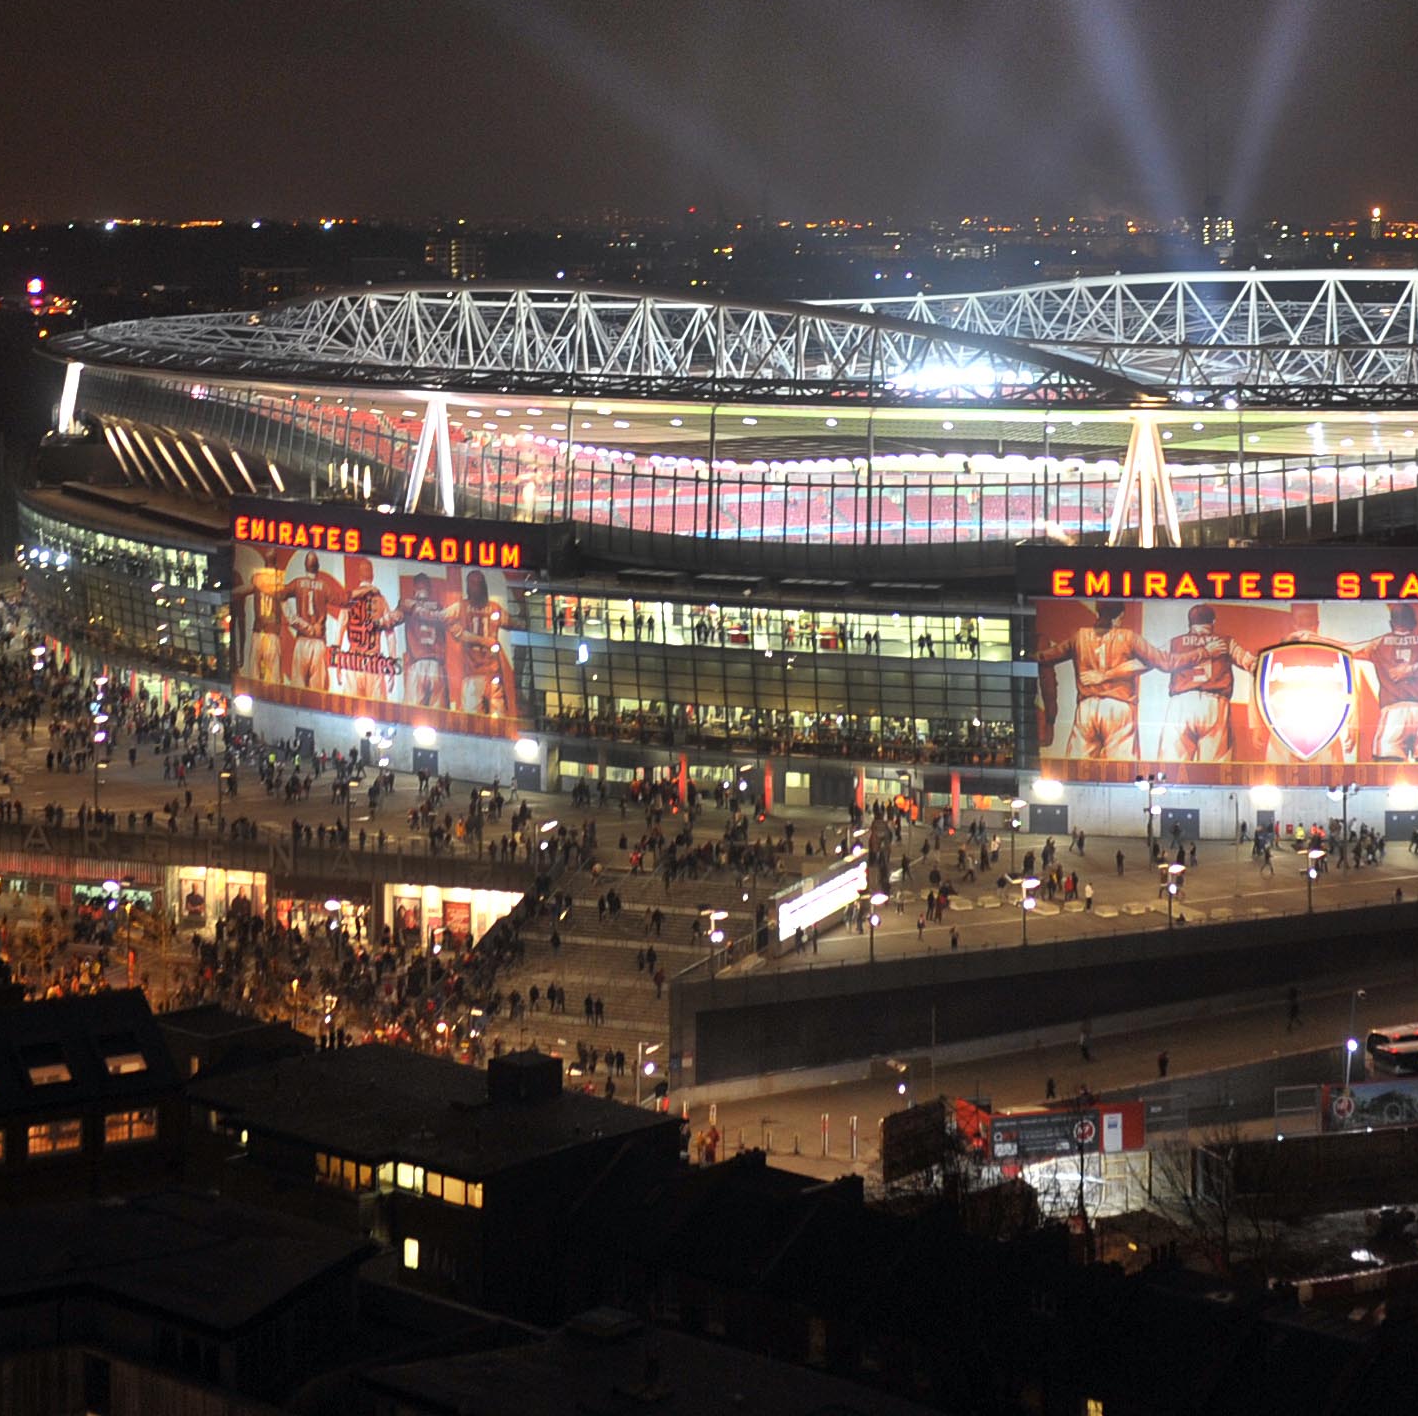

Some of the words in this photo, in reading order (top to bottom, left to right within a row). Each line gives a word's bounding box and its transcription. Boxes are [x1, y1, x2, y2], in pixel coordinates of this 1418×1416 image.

[234, 515, 362, 554] EMIRATES
[380, 532, 522, 570] STADIUM
[1052, 569, 1298, 600] EMIRATES
